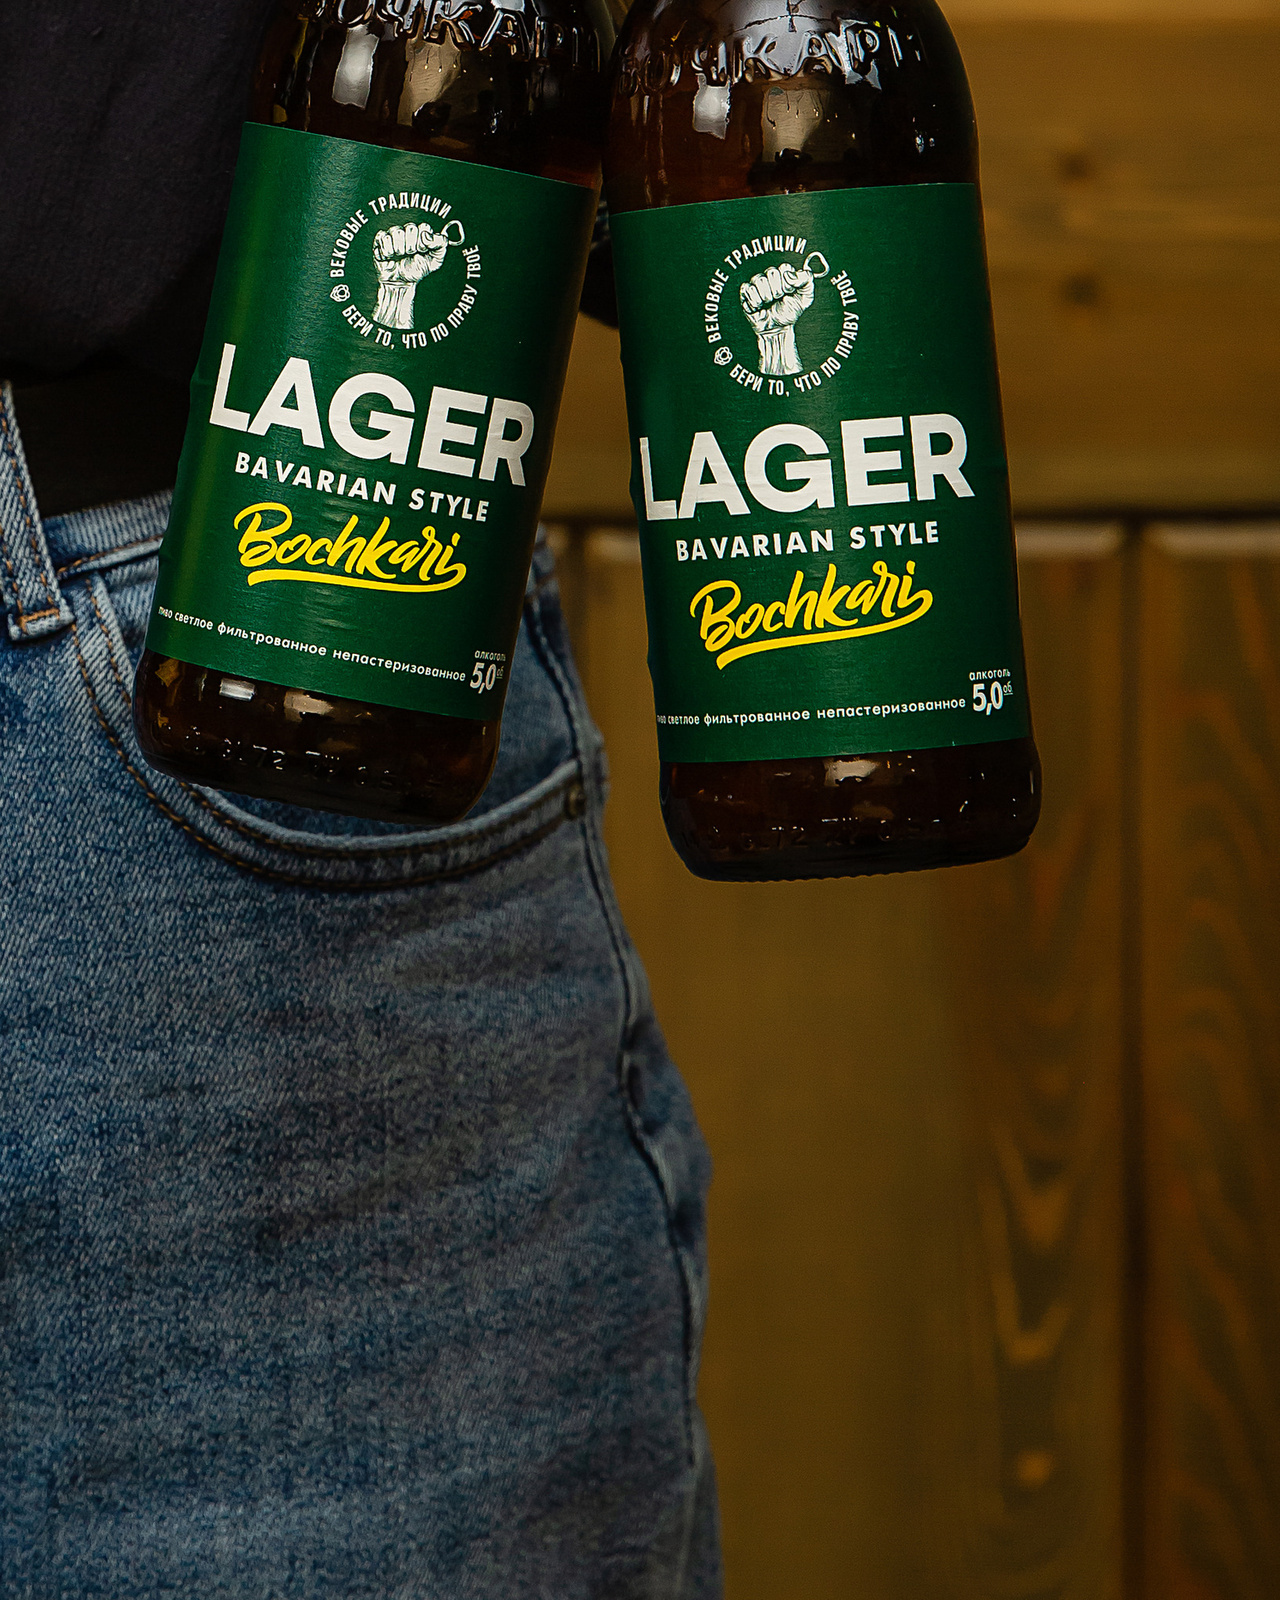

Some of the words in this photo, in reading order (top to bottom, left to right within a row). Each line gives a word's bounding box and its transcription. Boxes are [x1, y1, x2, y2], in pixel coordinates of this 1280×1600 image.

[329, 209, 369, 278] ВЕКОВЫЕ
[368, 192, 452, 219] ТРАДИЦИИ
[462, 245, 482, 279] ТВОЁ
[704, 269, 729, 344] ВЕКОВЫЕ
[724, 235, 807, 270] ТРАДИЦИИ
[830, 270, 857, 307] ТВОЁ
[342, 304, 374, 337] БЕРИ
[447, 284, 478, 328] ПРАВУ
[375, 328, 395, 349] ТО,
[401, 334, 427, 349] ЧТО
[430, 322, 449, 343] ПО
[834, 311, 859, 358] ПРАВУ
[729, 363, 764, 393] БЕРИ
[794, 371, 821, 393] ЧТО
[820, 356, 842, 379] ПО
[768, 379, 790, 397] ТО,
[209, 343, 535, 487] LAGER
[639, 413, 975, 521] LAGER
[234, 451, 397, 505] BAVARIAN
[409, 488, 489, 523] STYLE
[233, 502, 467, 593] Bochkari
[676, 529, 834, 562] BAVARIAN
[849, 521, 939, 550] STYLE
[689, 560, 933, 670] Bochkari
[174, 611, 214, 630] светлое
[217, 621, 327, 657] фильтрованное
[332, 648, 466, 682] непастеризованное
[469, 662, 497, 694] 5,0
[969, 669, 1011, 681] алкоголь
[668, 714, 700, 725] светлое
[703, 709, 811, 727] фильтрованное
[816, 697, 966, 719] непастеризованное
[972, 681, 1004, 715] 5,0
